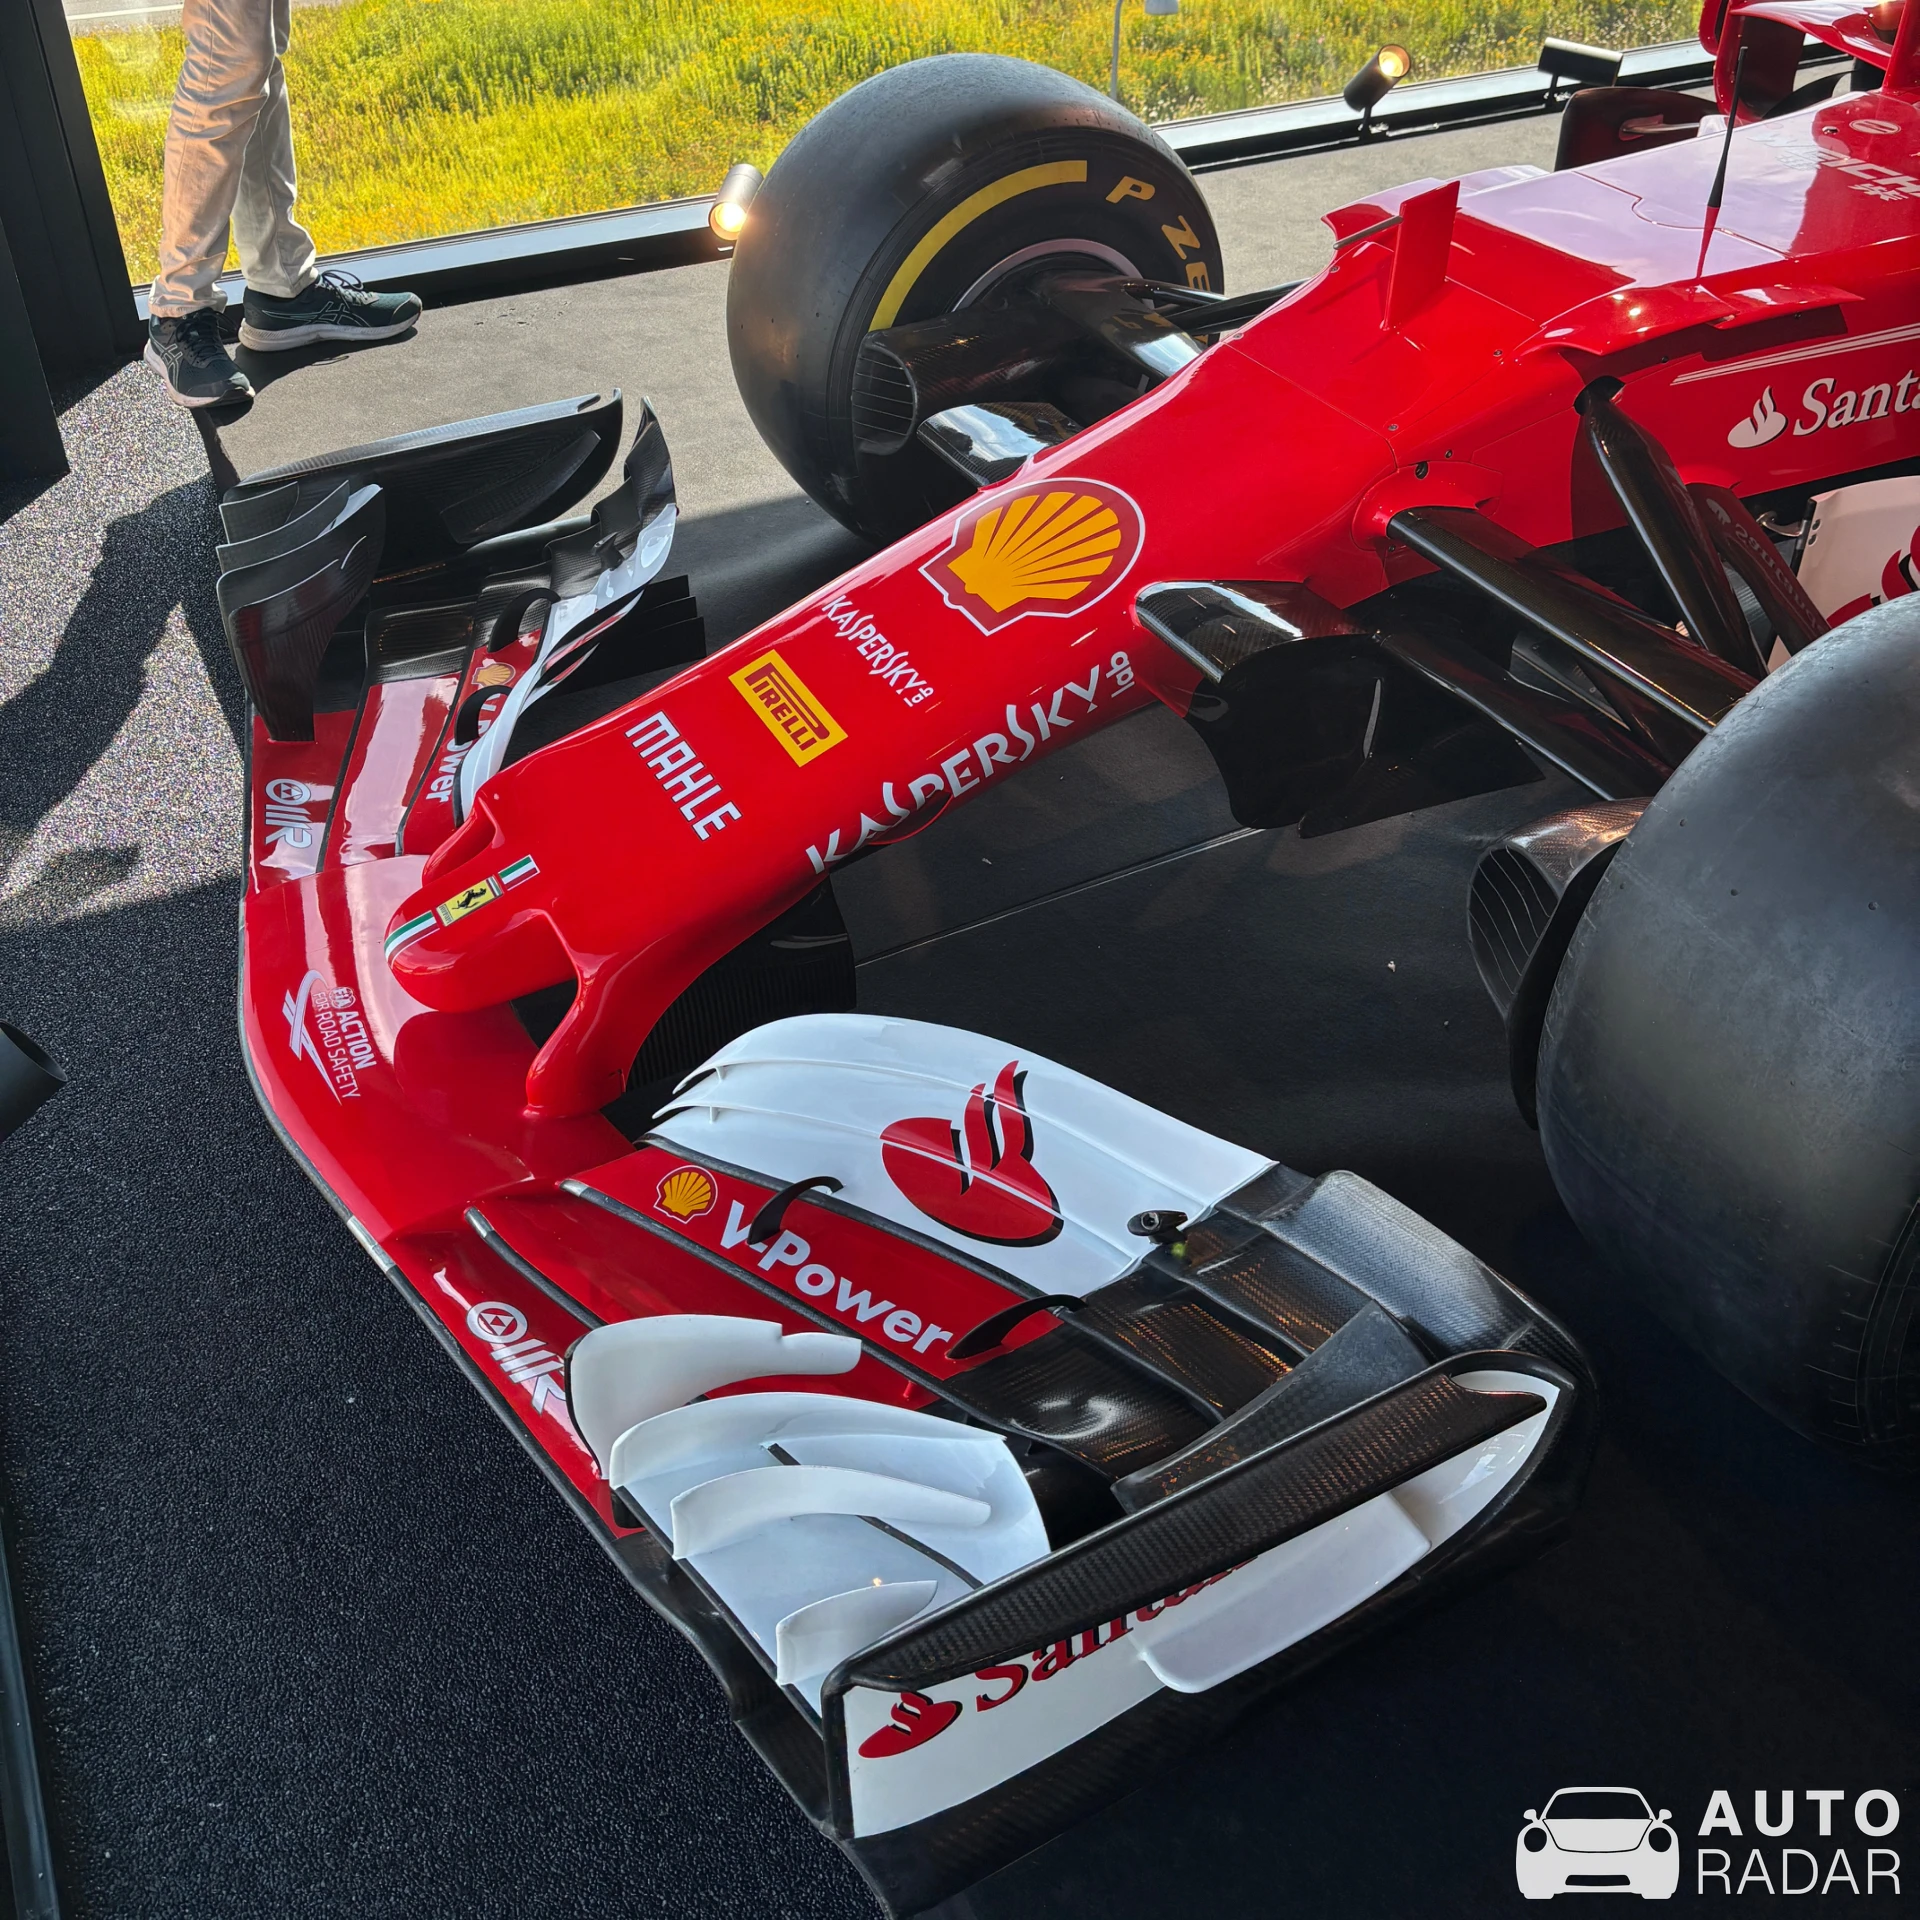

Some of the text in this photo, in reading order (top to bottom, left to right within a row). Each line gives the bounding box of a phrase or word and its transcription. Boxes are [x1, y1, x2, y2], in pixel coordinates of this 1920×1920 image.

[1105, 175, 1156, 204] P
[821, 595, 934, 707] KASPERSKY lab
[744, 662, 830, 752] PIRELLI
[624, 709, 744, 842] MAHLE
[805, 650, 1135, 875] KASPERSKY lab
[313, 991, 361, 1098] FOR ROAD SAFETY
[337, 1011, 377, 1070] ACTION
[720, 1200, 953, 1354] V-Power
